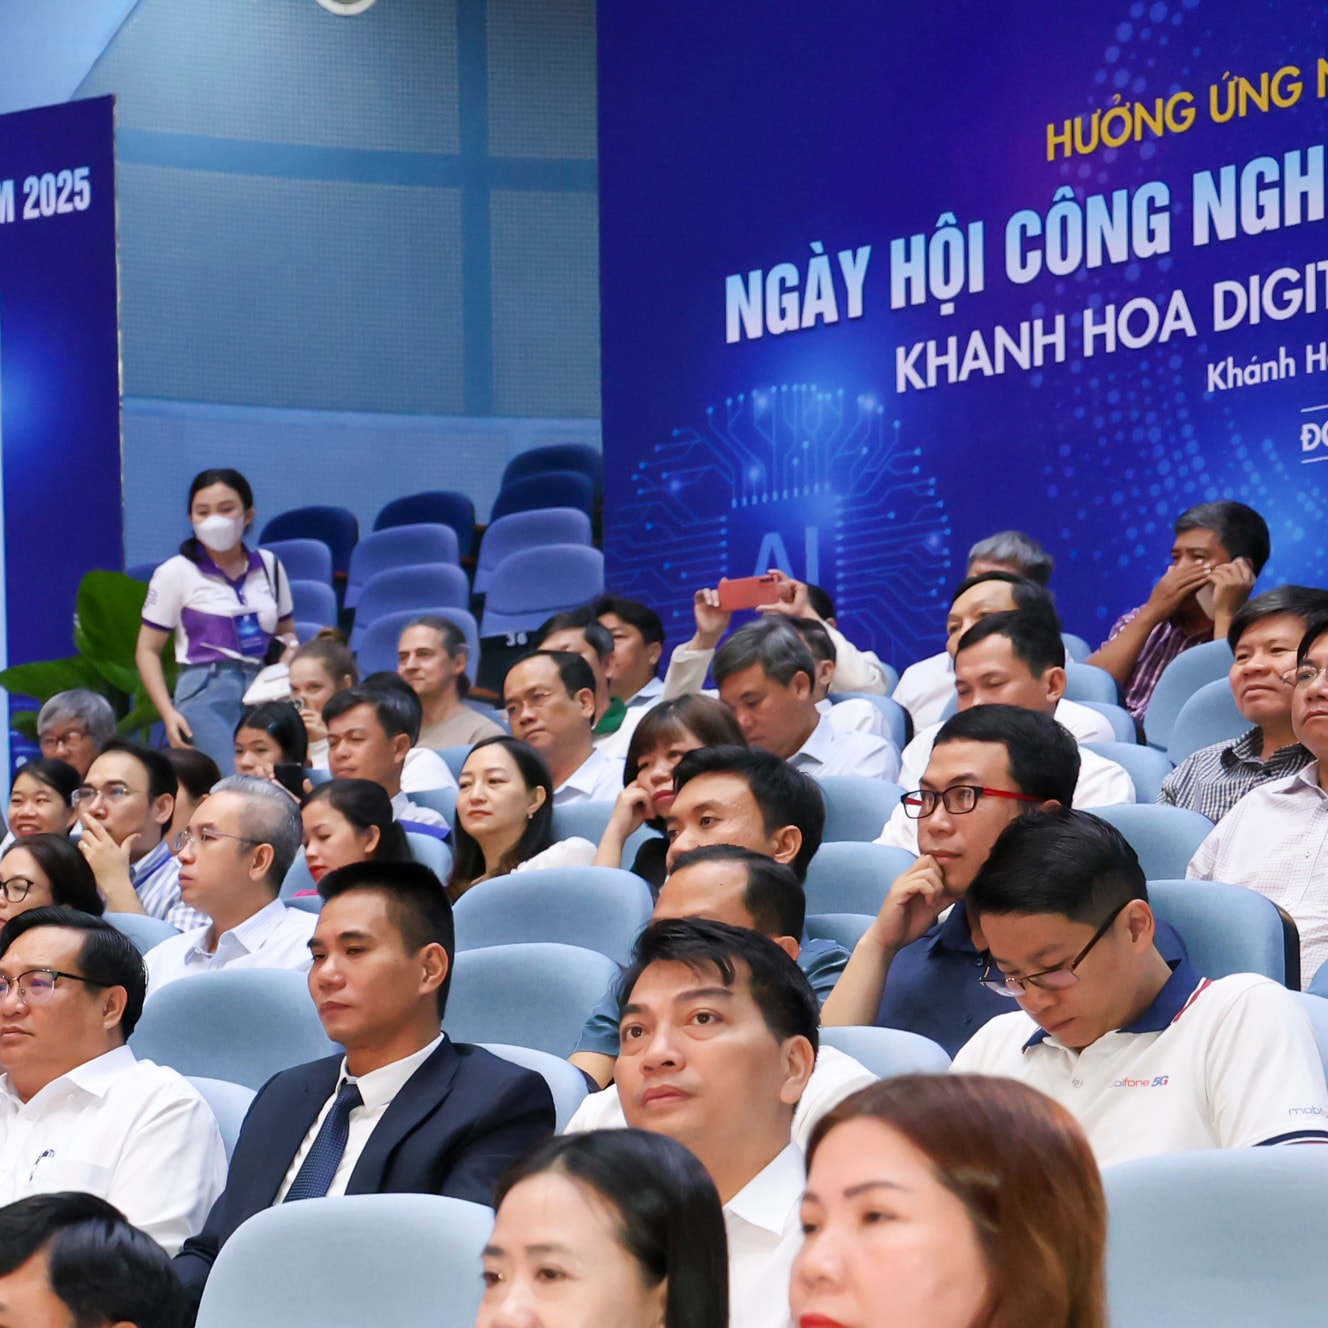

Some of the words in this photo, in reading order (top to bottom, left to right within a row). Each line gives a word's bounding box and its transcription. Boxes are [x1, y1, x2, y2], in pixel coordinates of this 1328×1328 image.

[1047, 92, 1197, 162] HƯỞNG
[1209, 70, 1304, 125] ỨNG
[23, 166, 91, 221] 2025
[725, 241, 871, 344] NGÀY
[889, 211, 985, 316] HỘI
[1004, 185, 1171, 286] CÔNG
[1192, 143, 1328, 246] NGH
[895, 315, 1066, 393] KHANH
[1082, 289, 1197, 358] HOA
[1213, 259, 1328, 332] DIGIT
[1207, 346, 1295, 392] Khánh
[754, 526, 819, 585] AI
[1151, 1075, 1169, 1087] 5G
